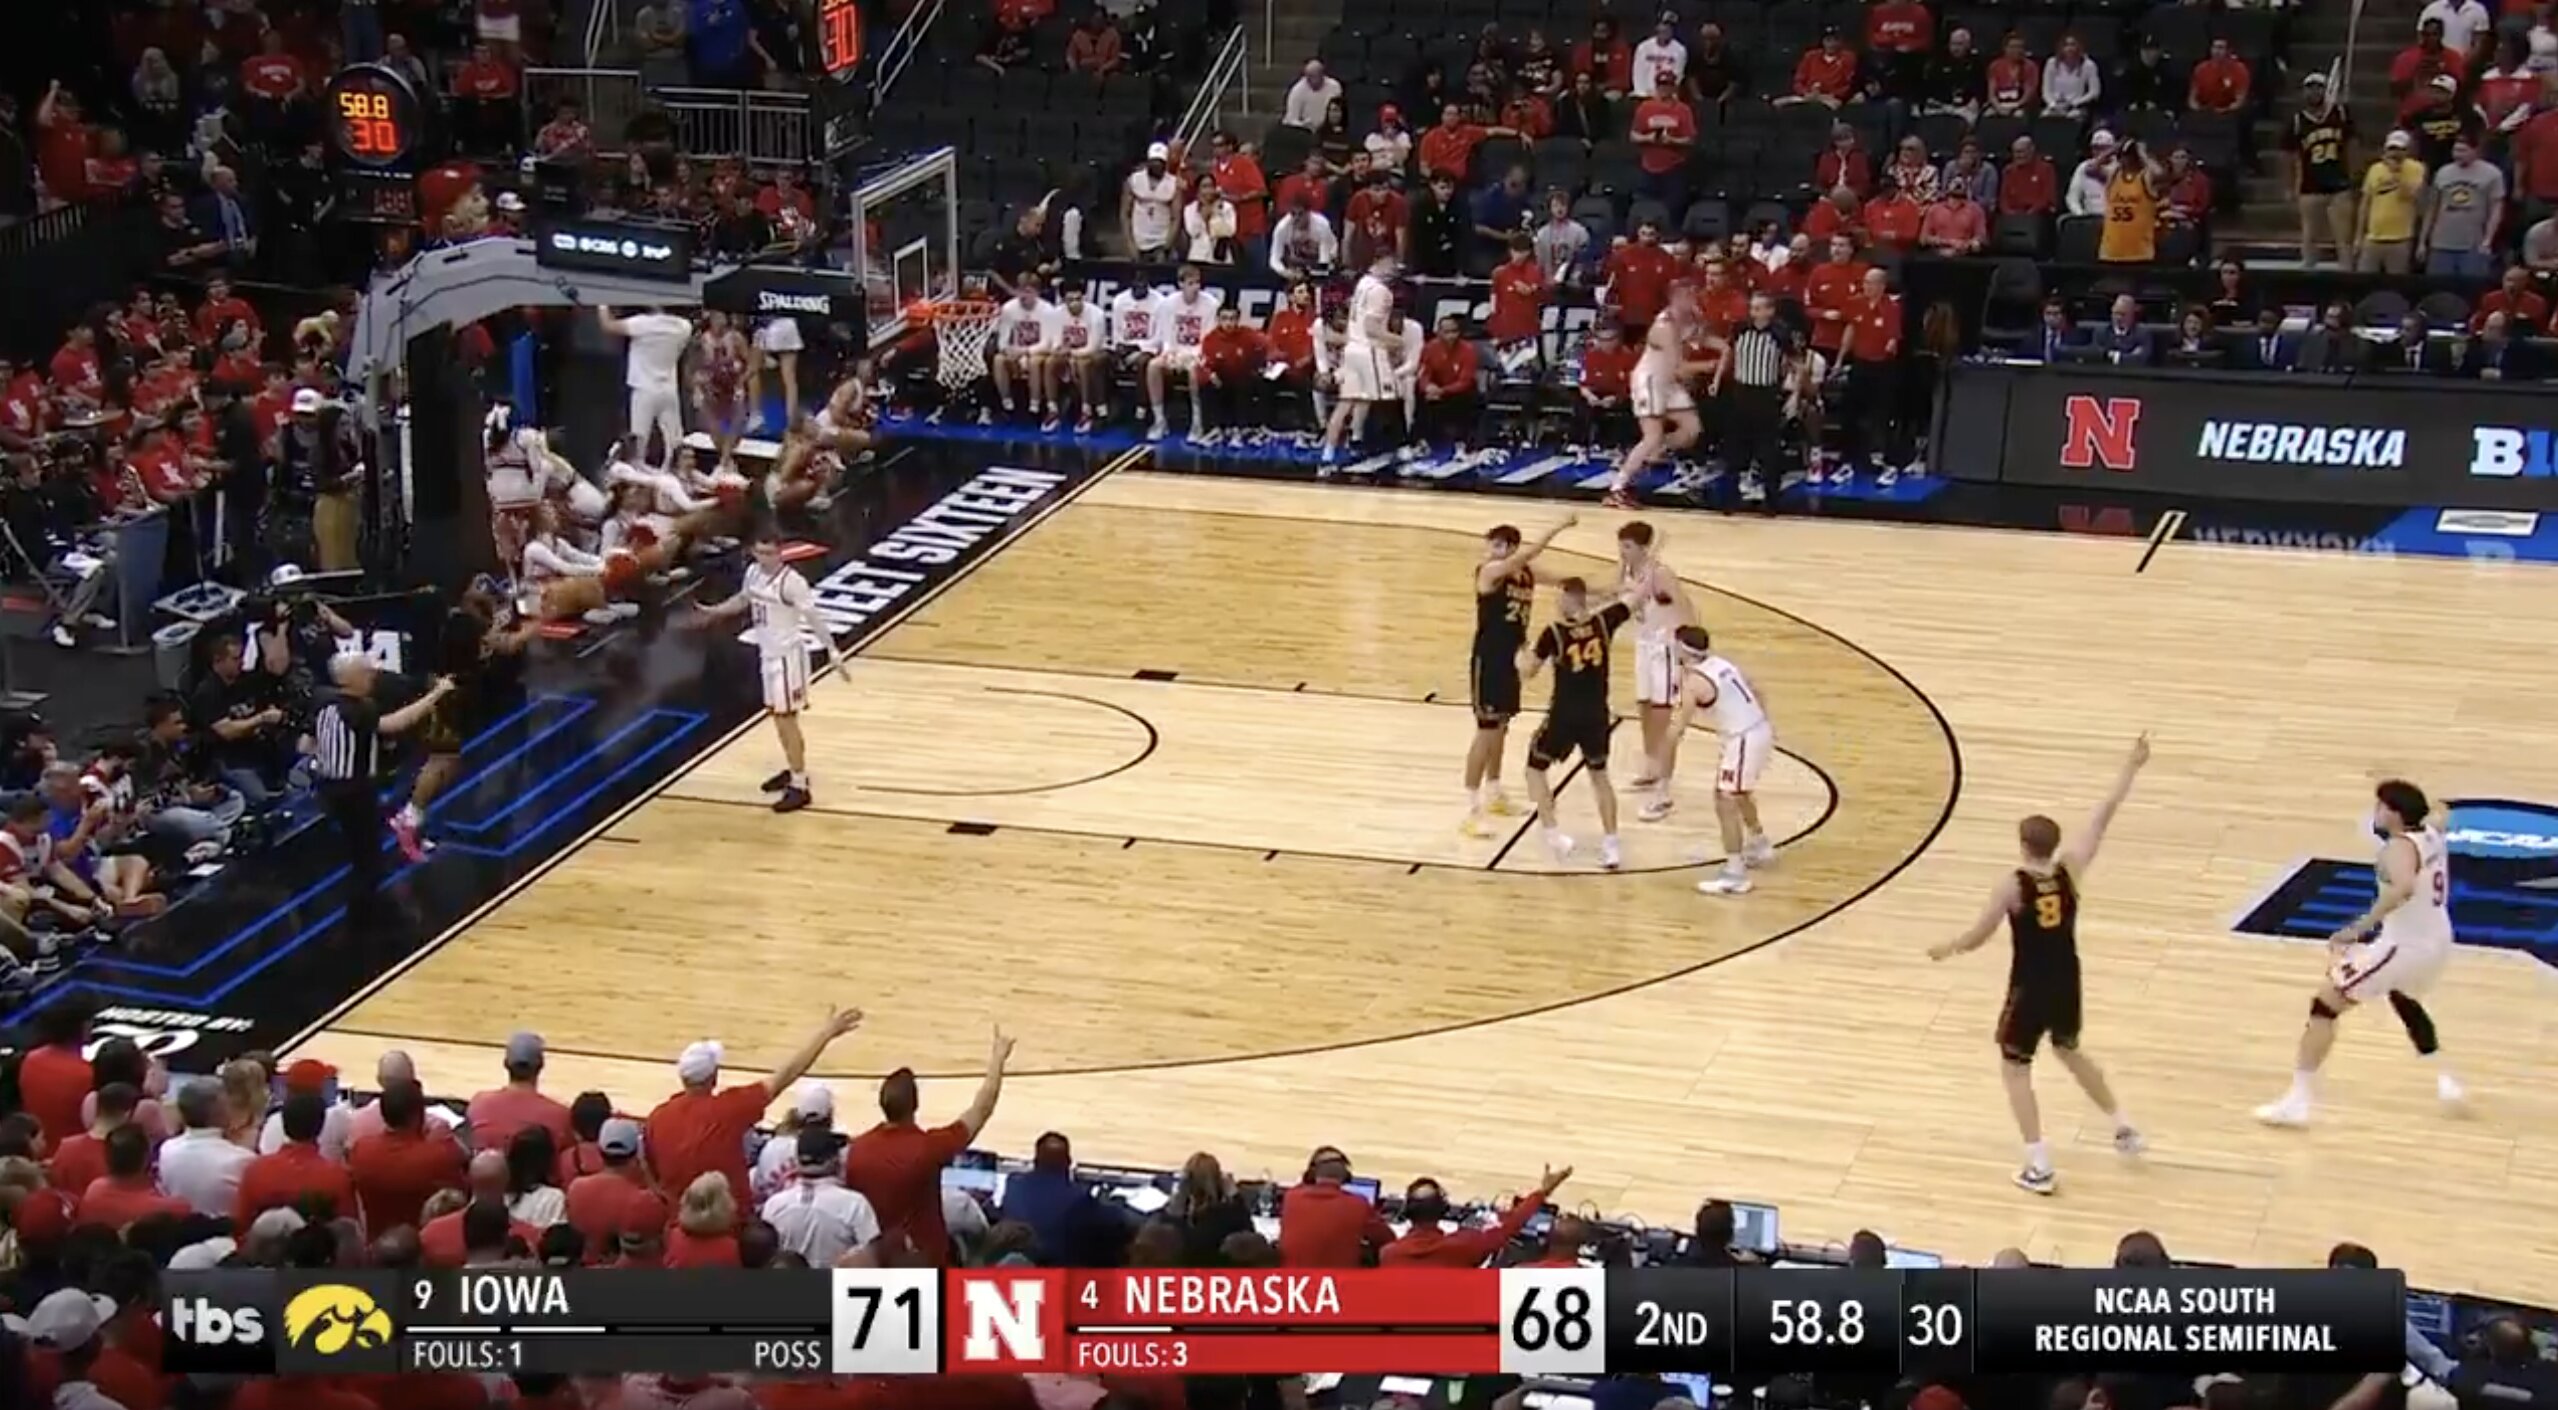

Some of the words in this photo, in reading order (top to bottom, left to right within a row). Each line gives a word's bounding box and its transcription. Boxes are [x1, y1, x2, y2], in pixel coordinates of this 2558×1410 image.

[824, 3, 857, 71] 30
[340, 92, 389, 119] 58.8
[351, 119, 397, 150] 30
[759, 290, 830, 315] SPALDING
[2061, 396, 2141, 470] N
[2197, 420, 2406, 468] NEBRASKA
[867, 465, 1068, 565] SIXTEEN
[1566, 636, 1603, 672] 14
[1731, 677, 1752, 705] 1
[2432, 870, 2445, 908] 9
[2035, 894, 2061, 928] 8
